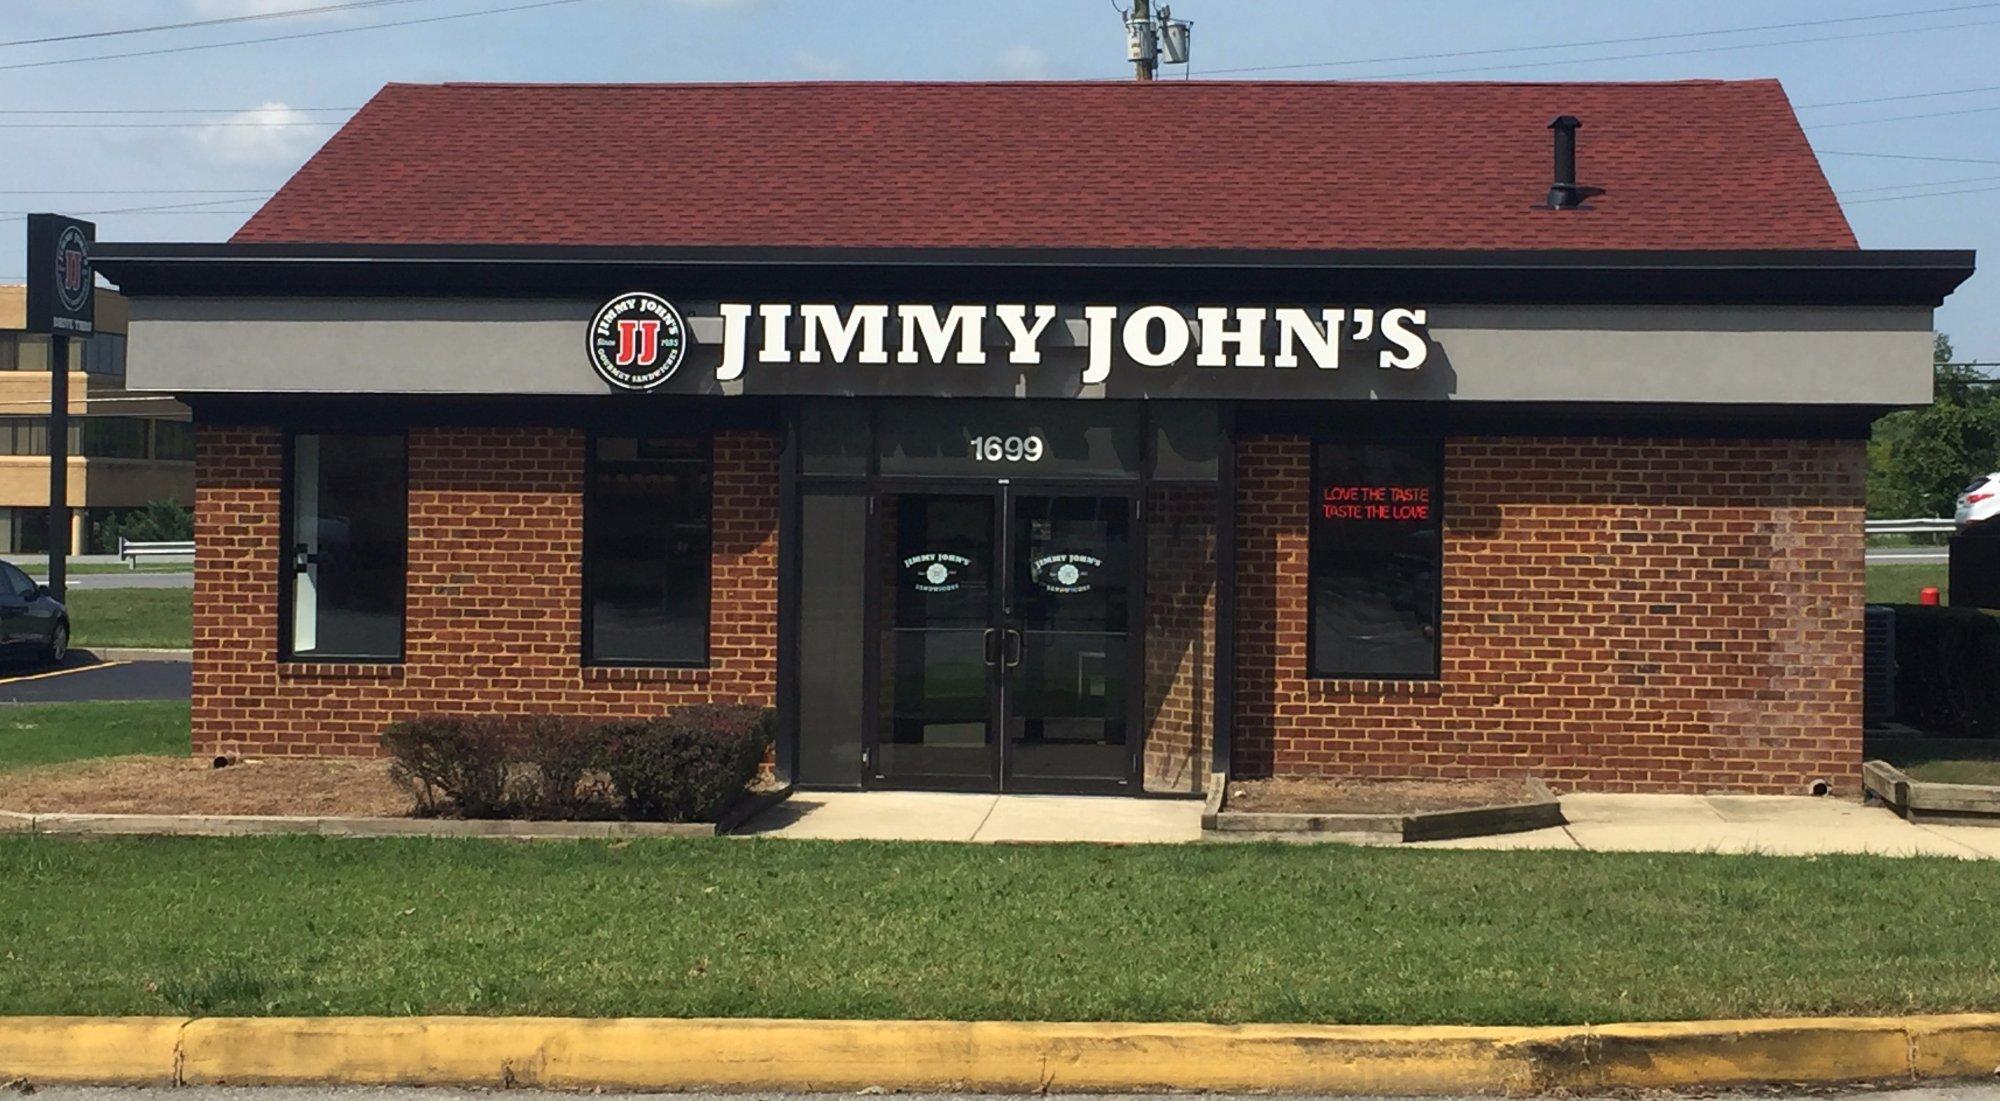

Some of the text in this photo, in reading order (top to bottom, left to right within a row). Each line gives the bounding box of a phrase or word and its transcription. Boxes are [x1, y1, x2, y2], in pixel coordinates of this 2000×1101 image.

[598, 299, 679, 336] JIMMY JOHN'S
[616, 320, 661, 365] JJ
[716, 304, 1428, 384] JIMMY JOHN'S
[970, 435, 1044, 462] 1699
[1323, 487, 1430, 503] LOVE THE TASTE
[1323, 504, 1430, 520] TASTE THE LOVE
[904, 553, 971, 569] JIMMY JOHN'S
[1034, 554, 1102, 570] JIMMY JOHN'S
